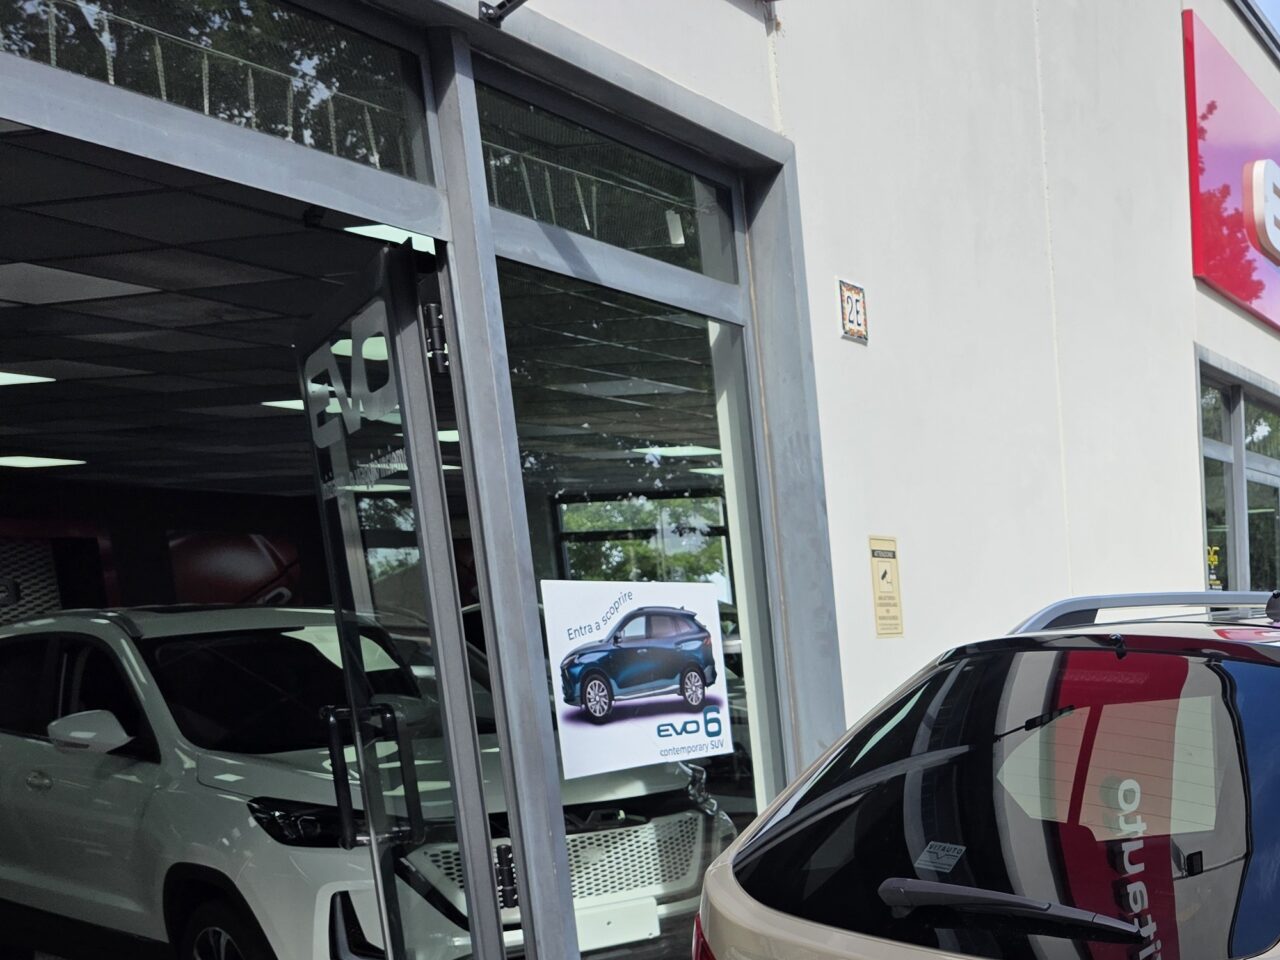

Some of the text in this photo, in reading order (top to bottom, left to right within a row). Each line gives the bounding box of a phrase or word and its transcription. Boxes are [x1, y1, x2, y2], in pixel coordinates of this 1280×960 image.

[845, 295, 862, 327] 2E
[305, 300, 399, 448] EVO
[567, 590, 633, 641] Entra a scoprire
[656, 705, 722, 738] EVO 6
[659, 739, 725, 757] contemporary SUV
[929, 843, 963, 856] VITAUTO
